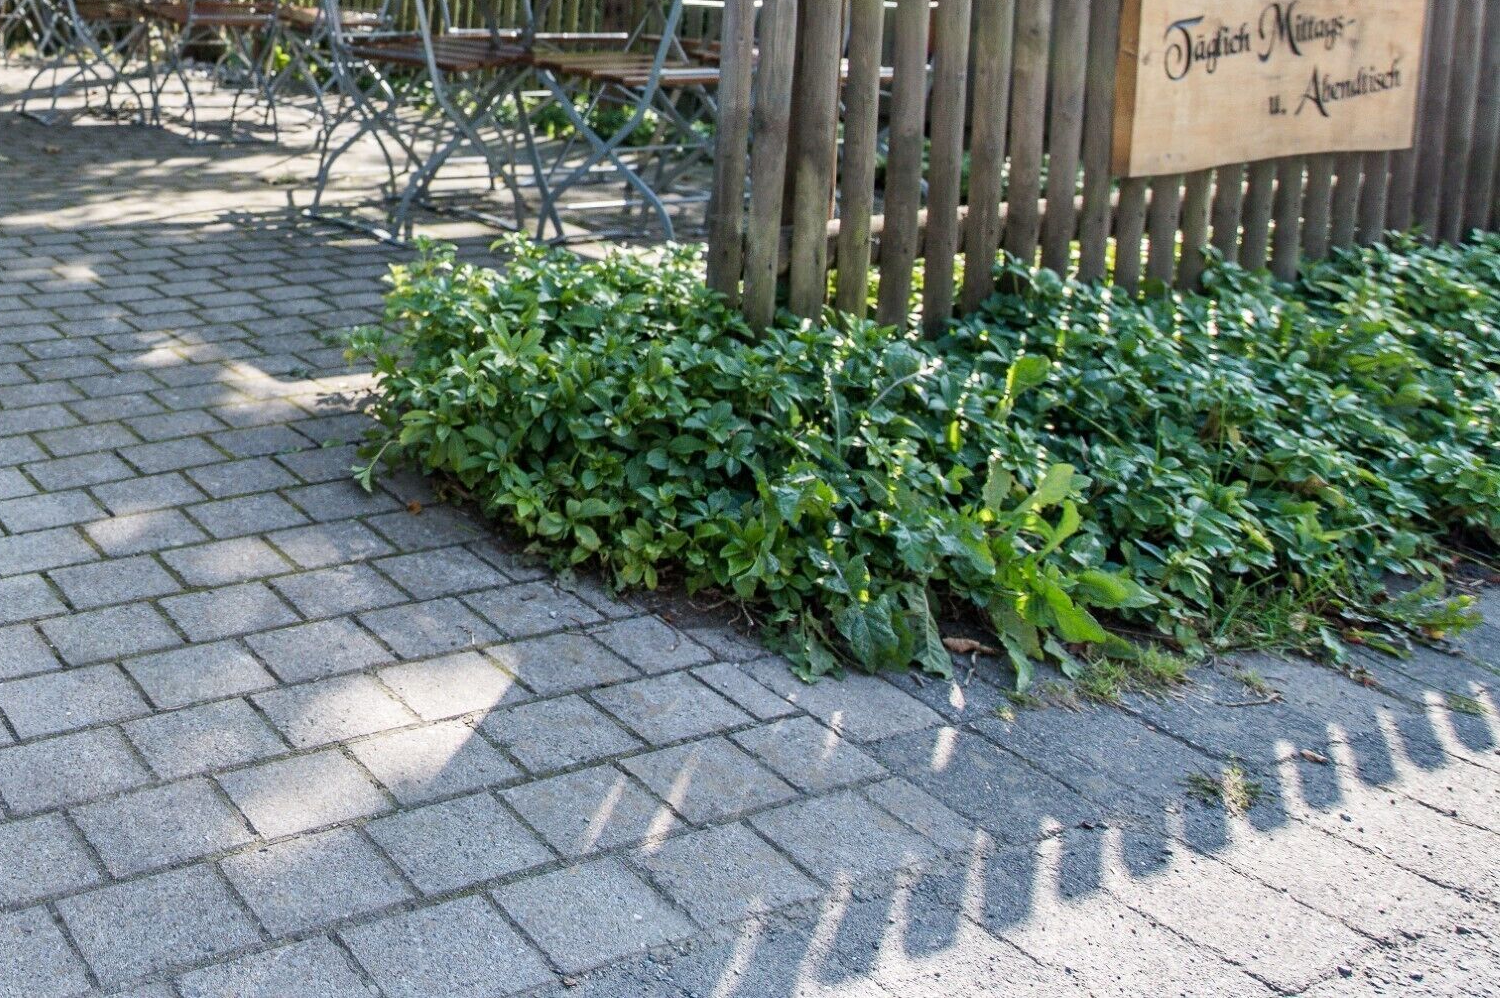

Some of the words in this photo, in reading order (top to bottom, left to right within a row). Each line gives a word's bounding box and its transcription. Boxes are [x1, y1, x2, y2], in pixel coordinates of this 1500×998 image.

[1164, 15, 1251, 81] Täglich
[1268, 95, 1287, 116] u.
[1294, 55, 1403, 118] Abendtisch
